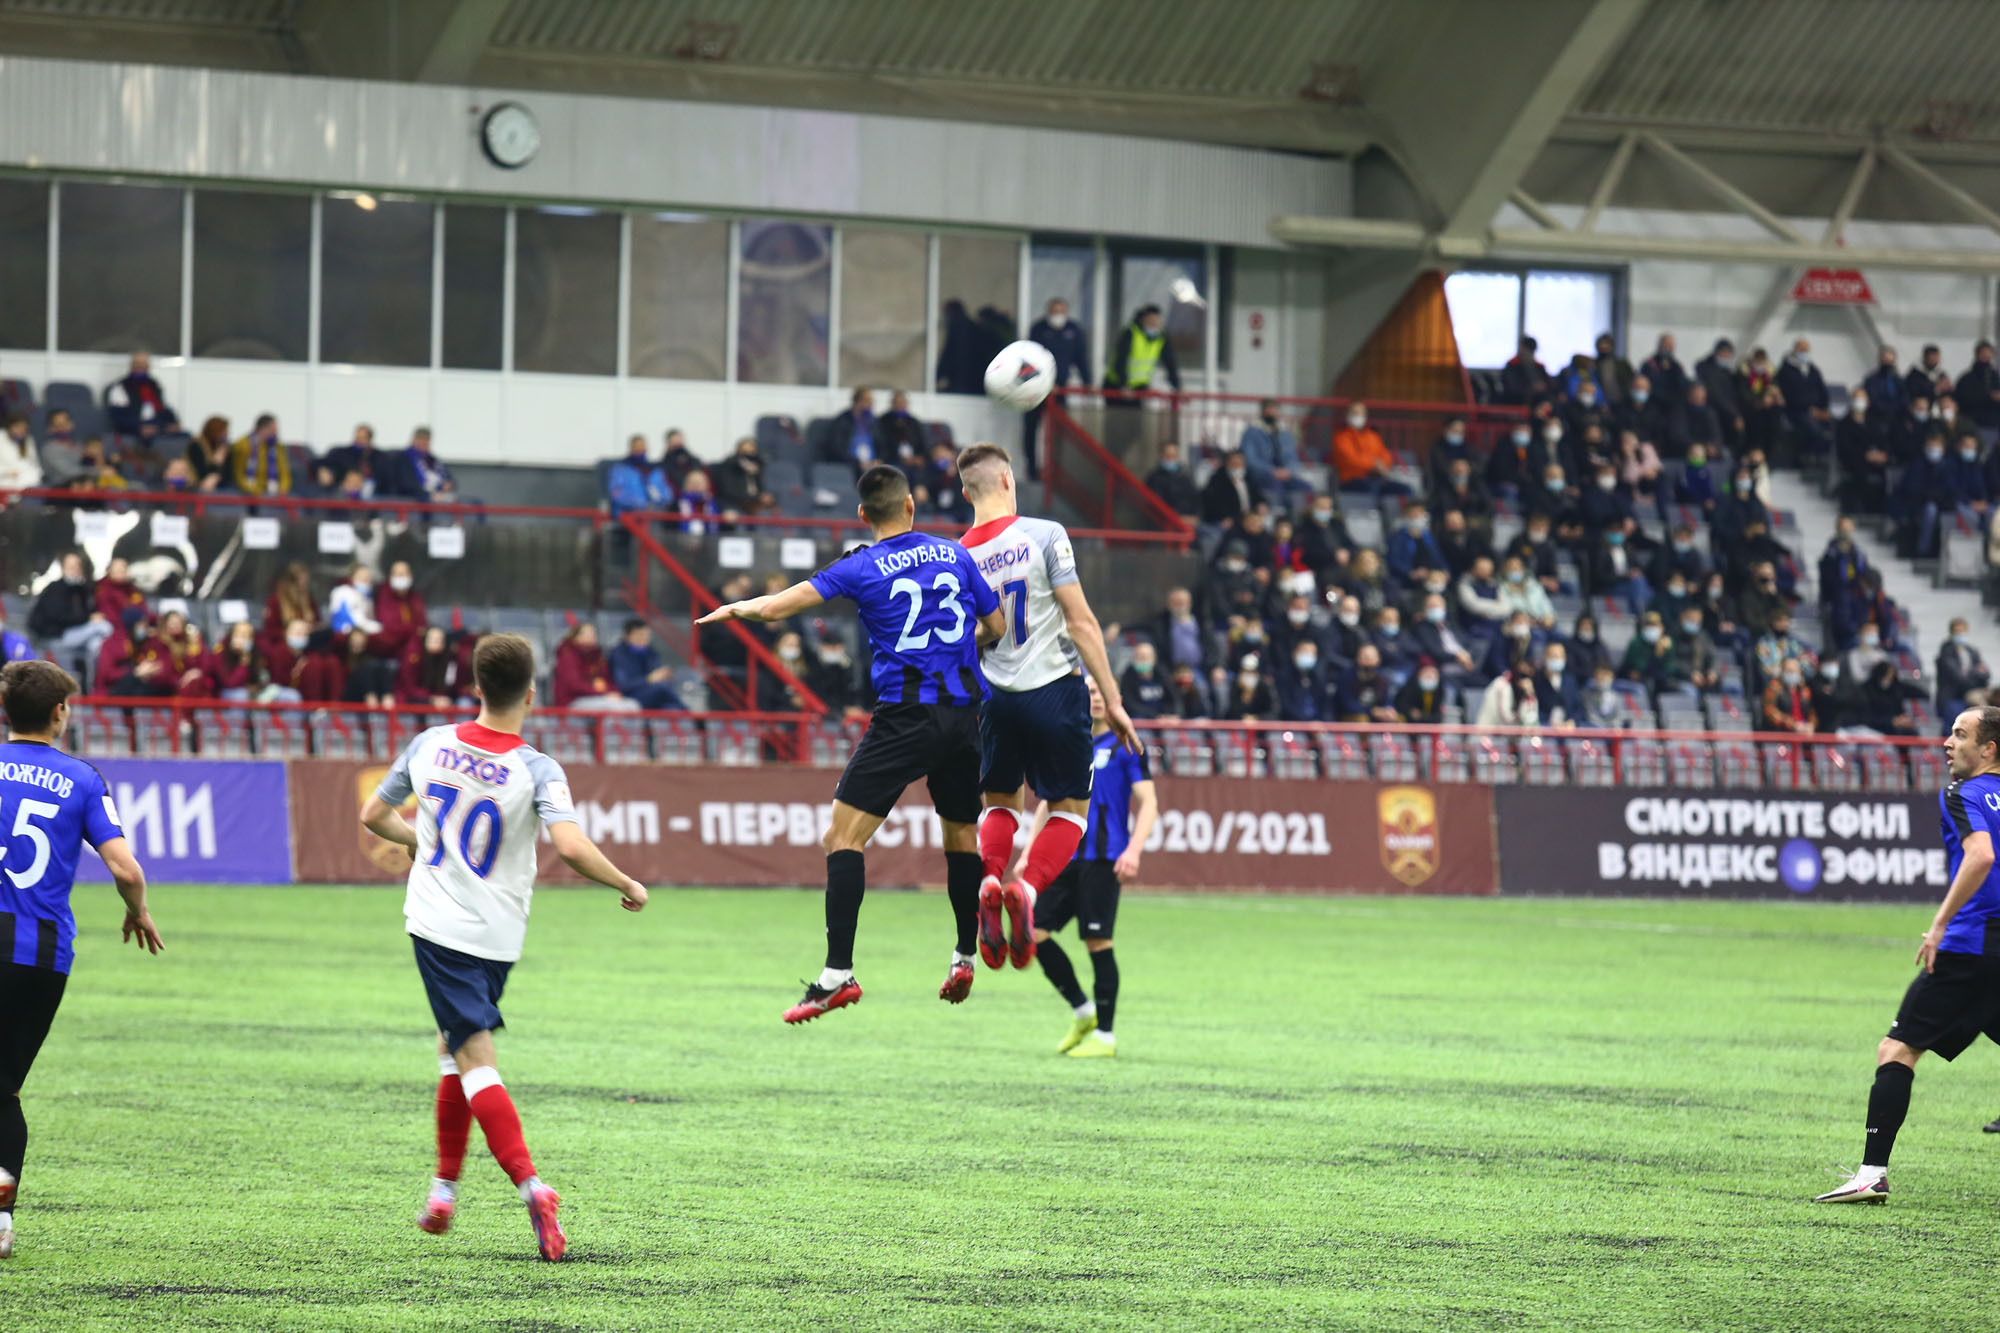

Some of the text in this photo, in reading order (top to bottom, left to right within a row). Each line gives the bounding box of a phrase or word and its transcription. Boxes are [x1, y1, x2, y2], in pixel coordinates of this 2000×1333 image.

[875, 545, 957, 576] КОЗУБАЕВ
[889, 572, 966, 653] 23
[435, 747, 511, 786] ПУХОВ
[422, 779, 504, 880] 70
[1625, 798, 1910, 840] СМОТРИТЕ ФНЛ
[1599, 843, 1947, 887] В ЯНДЕКС ЭФИРЕ
